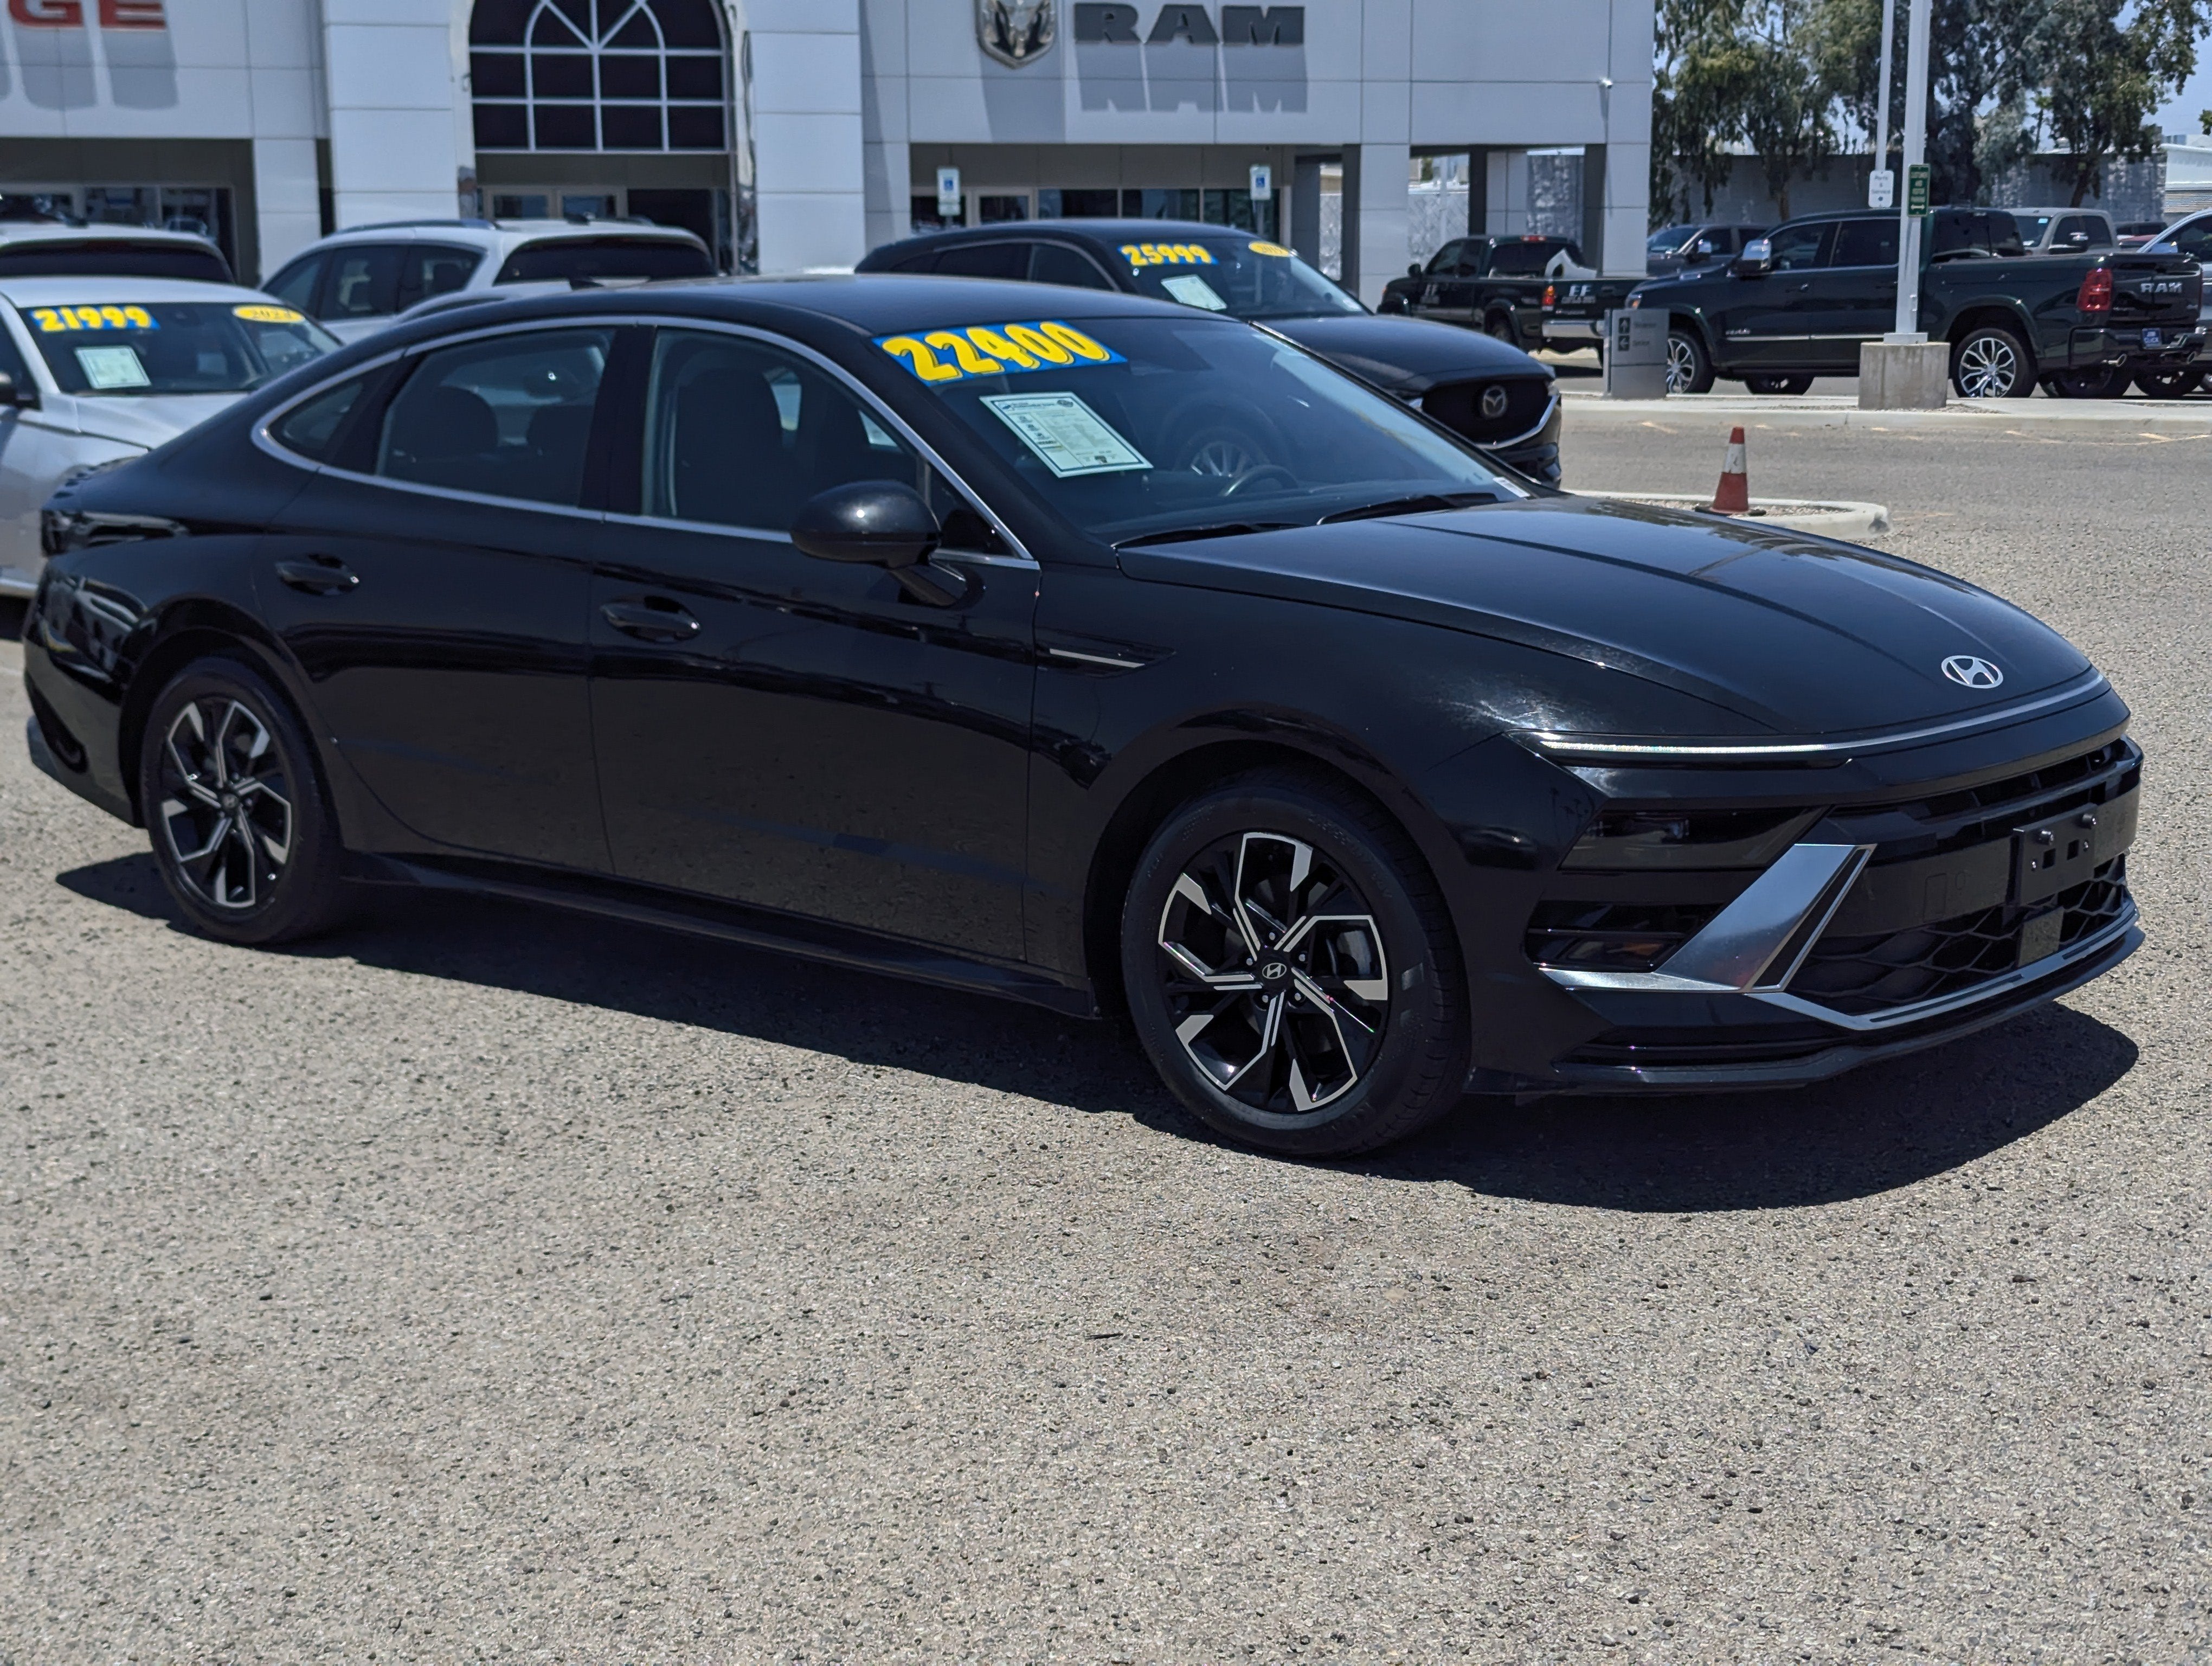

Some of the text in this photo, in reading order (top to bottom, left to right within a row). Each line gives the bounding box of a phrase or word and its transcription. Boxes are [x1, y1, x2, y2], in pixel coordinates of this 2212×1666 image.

[1073, 2, 1304, 47] RAM
[1121, 244, 1212, 266] 25999
[2140, 281, 2183, 293] RAM
[33, 305, 151, 332] 21999
[882, 321, 1110, 382] 22400
